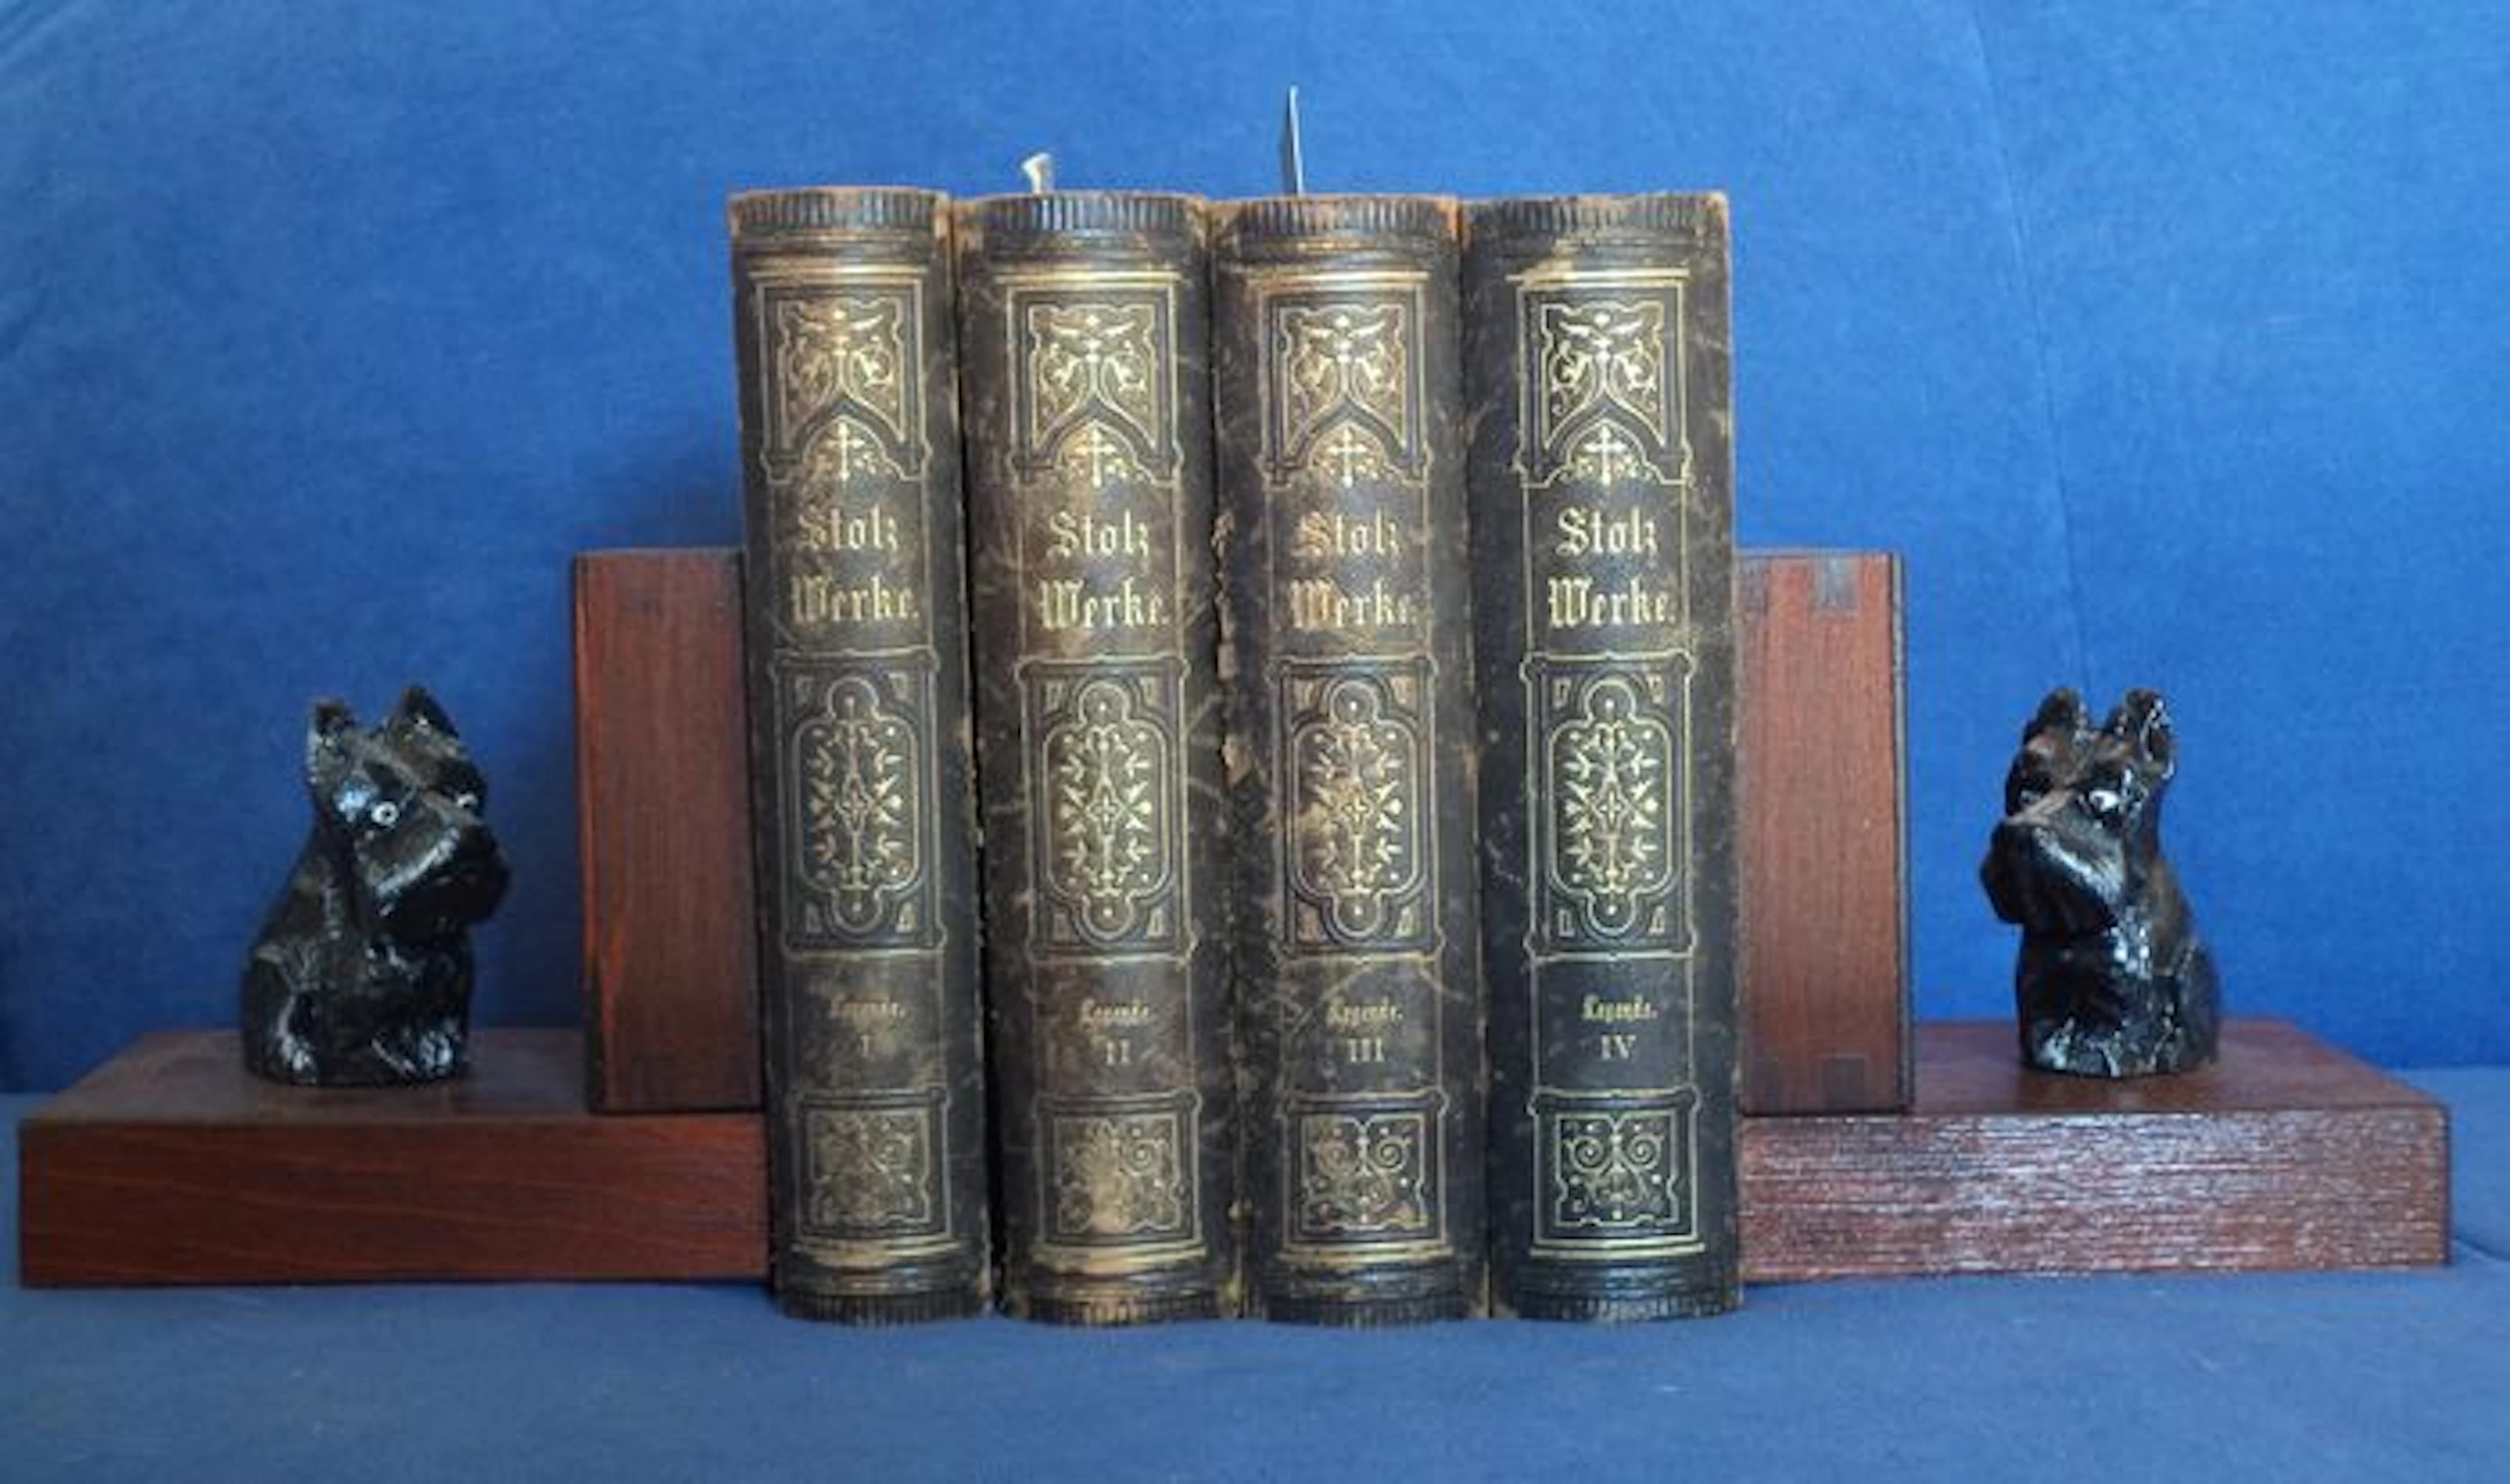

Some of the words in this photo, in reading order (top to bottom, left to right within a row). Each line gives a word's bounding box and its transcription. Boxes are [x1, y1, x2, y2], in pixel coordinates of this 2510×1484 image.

[797, 504, 899, 552] Stolz
[1046, 508, 1149, 559] Stolz
[1292, 506, 1403, 559] Stolz
[1555, 504, 1658, 563] Stolz
[1105, 1039, 1131, 1067] II
[1347, 1037, 1385, 1063] III
[1601, 1034, 1637, 1060] IV
